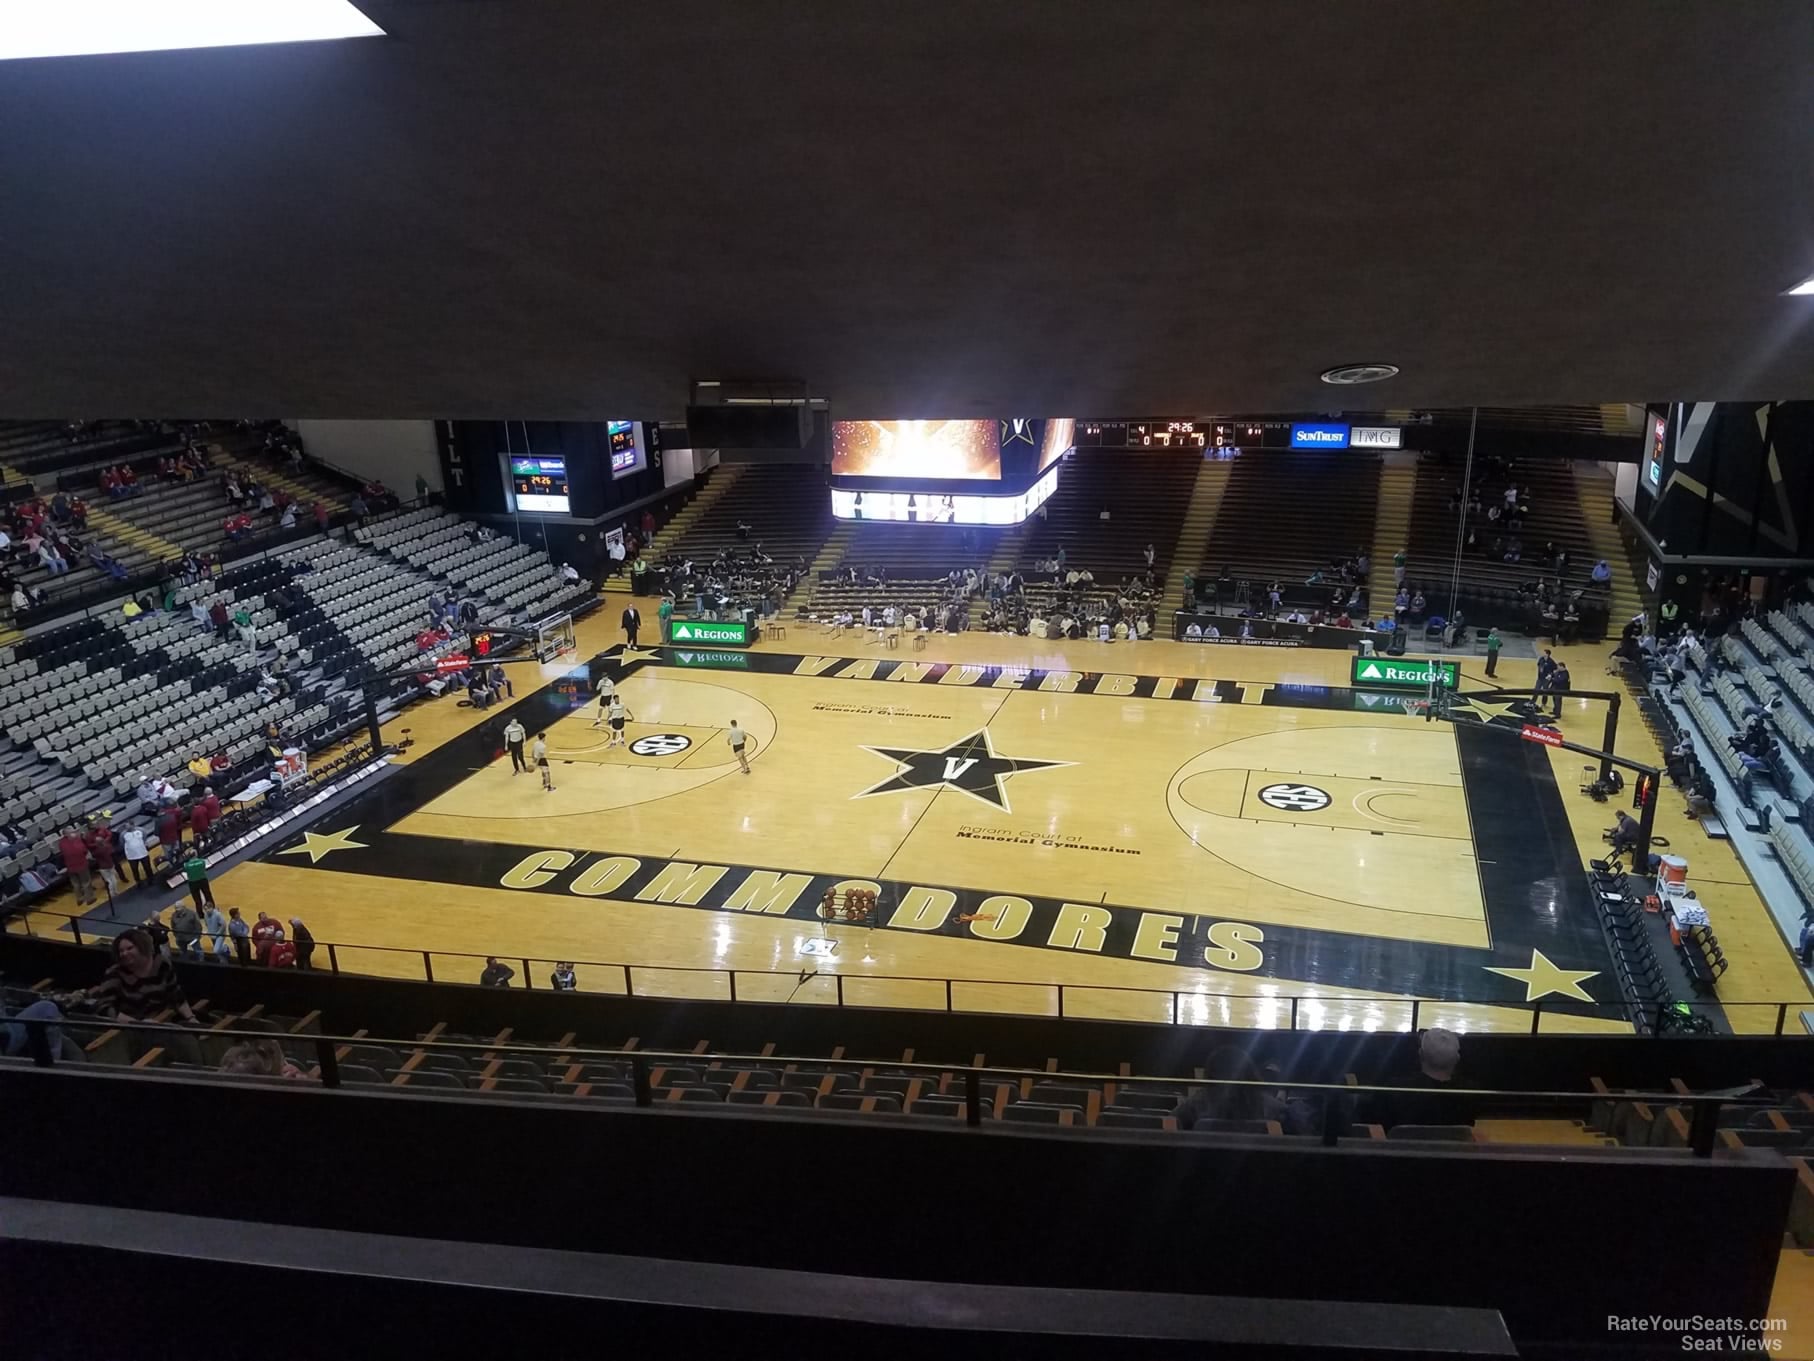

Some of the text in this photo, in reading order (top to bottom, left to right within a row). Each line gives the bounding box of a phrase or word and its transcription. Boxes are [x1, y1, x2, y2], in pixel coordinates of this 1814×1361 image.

[1359, 430, 1392, 443] IMG
[694, 628, 742, 640] REGIONS
[792, 655, 1275, 705] VANDERBILT
[942, 756, 980, 780] V
[959, 825, 1012, 836] Ingram
[1019, 830, 1062, 840] Court
[956, 831, 1142, 855] Memorial Gymnasium
